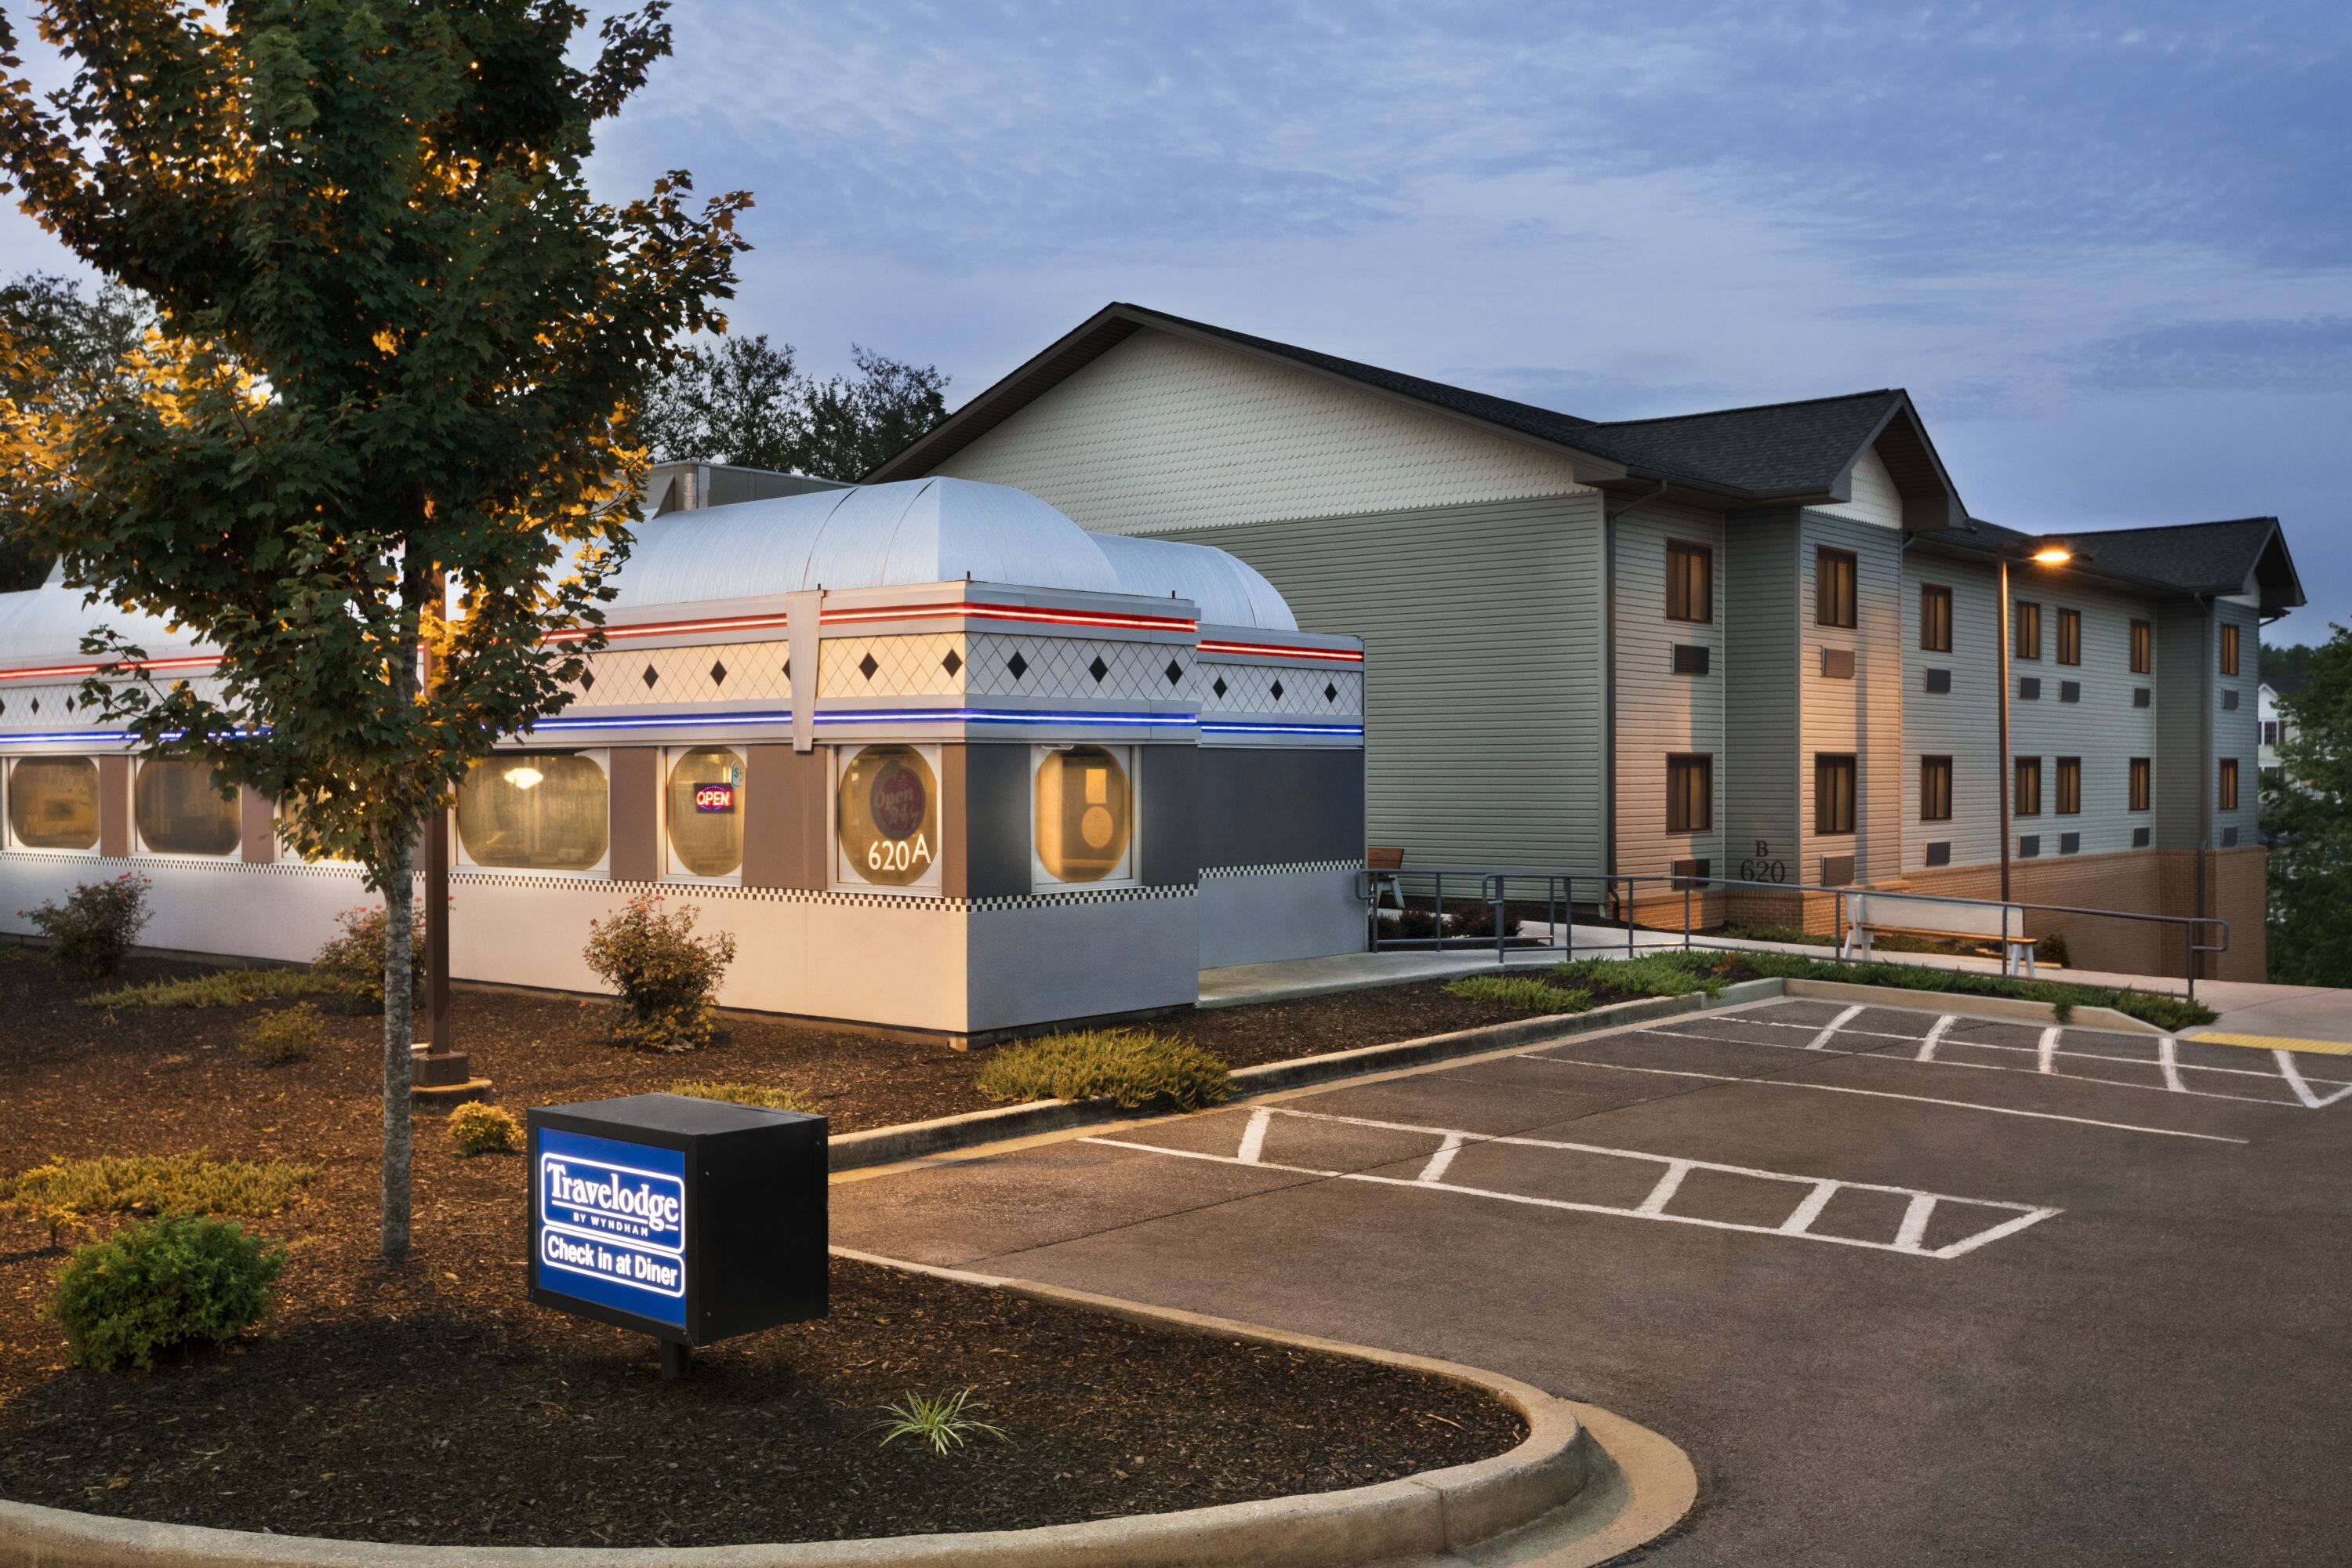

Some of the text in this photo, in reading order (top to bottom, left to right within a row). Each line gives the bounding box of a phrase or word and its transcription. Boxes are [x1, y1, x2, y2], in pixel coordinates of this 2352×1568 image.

[696, 791, 730, 806] OPEN
[874, 788, 913, 811] Open
[1755, 840, 1768, 857] B
[1740, 859, 1785, 884] 620
[546, 1162, 679, 1232] Travelodge
[573, 1212, 648, 1236] BY WYNDHAM
[547, 1235, 678, 1287] Check in at Diner
